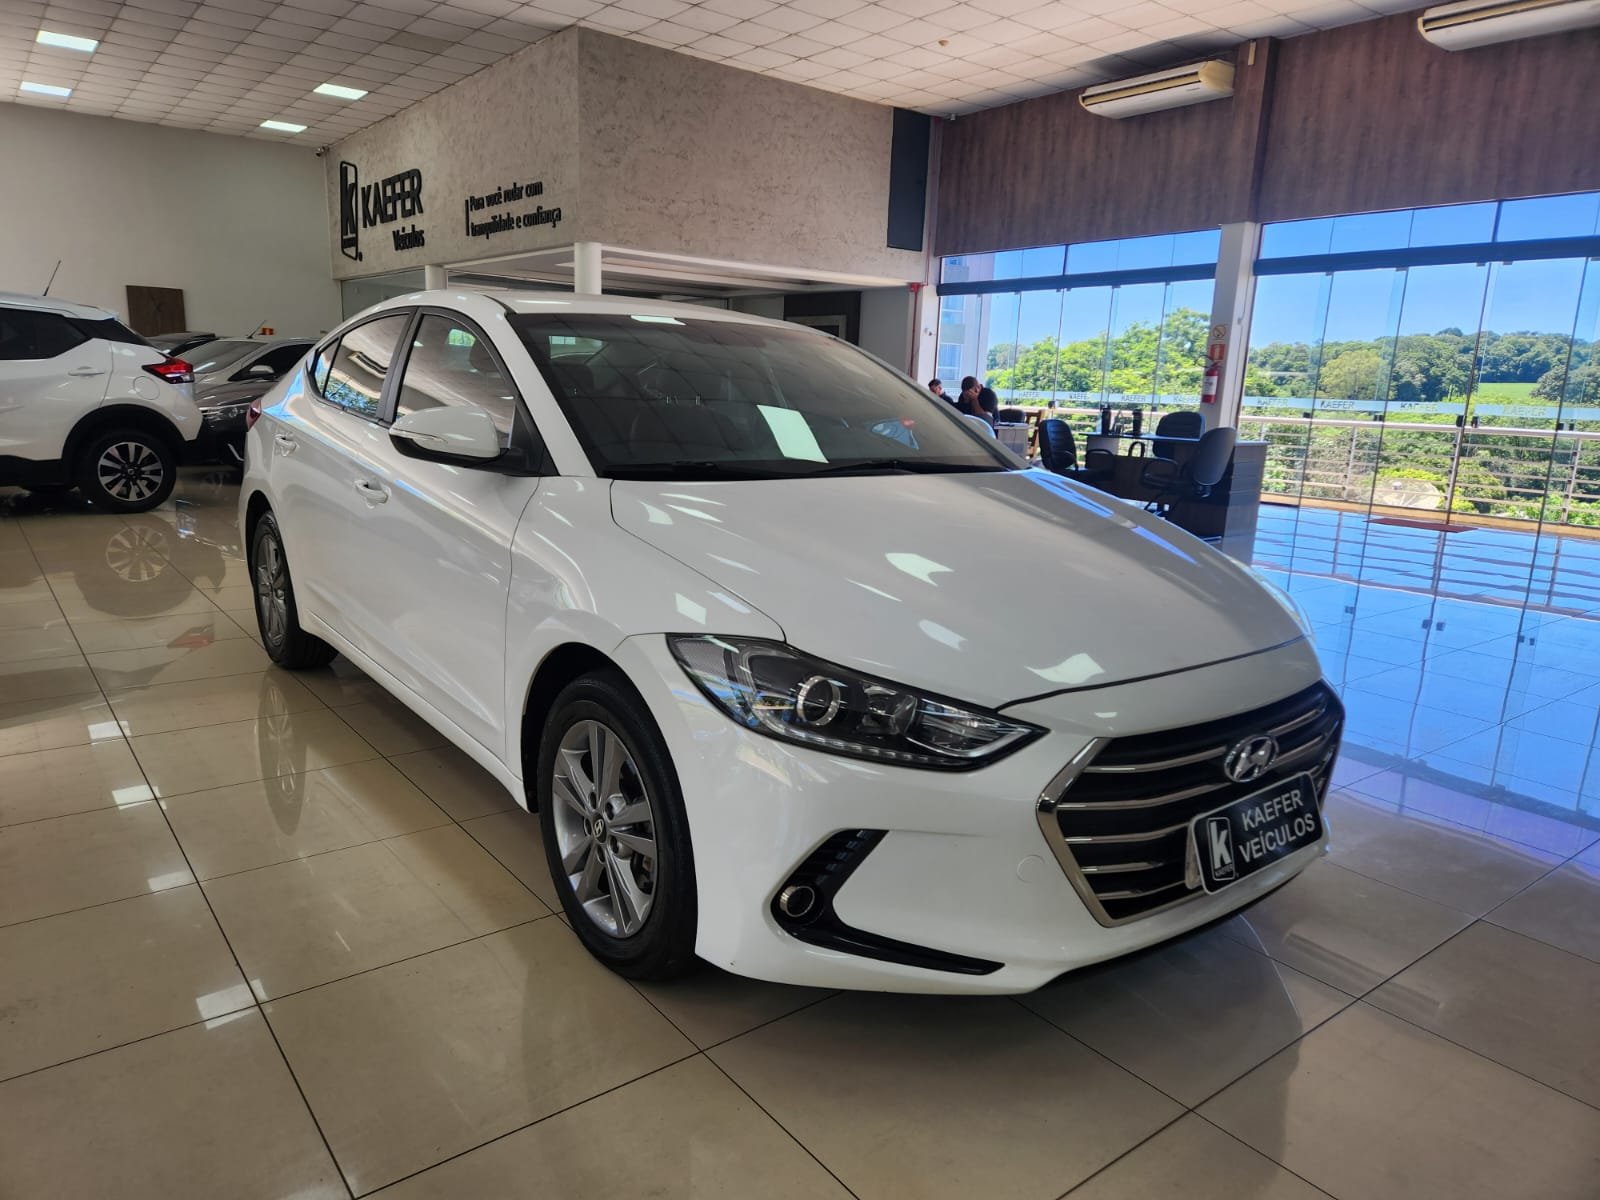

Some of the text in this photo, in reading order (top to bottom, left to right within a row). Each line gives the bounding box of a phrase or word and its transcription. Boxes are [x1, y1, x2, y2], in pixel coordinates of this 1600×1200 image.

[361, 168, 424, 229] KAEFER
[525, 181, 543, 198] com
[516, 215, 522, 228] e
[523, 205, 562, 228] confiança
[392, 224, 425, 251] Veículos
[1320, 400, 1355, 409] KAEFER
[1241, 789, 1304, 832] KAEFER
[1239, 813, 1316, 863] VEÍCULOS
